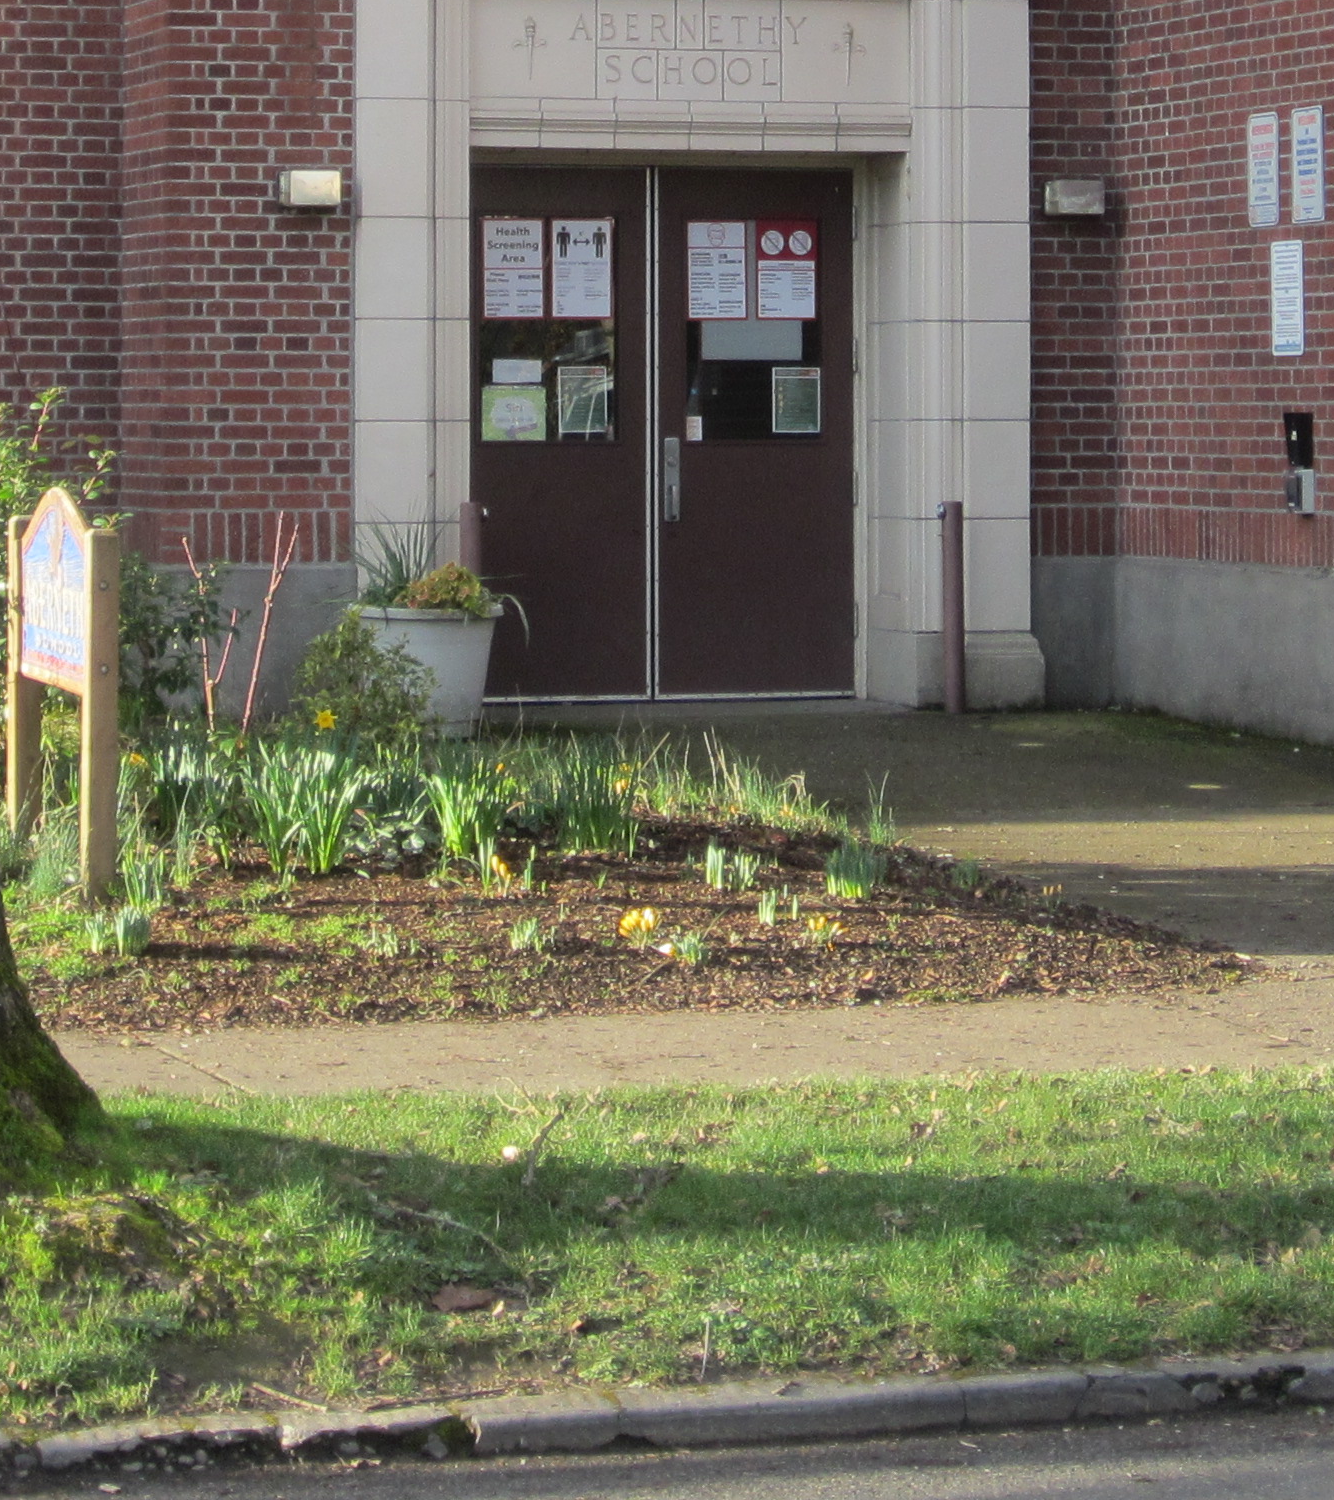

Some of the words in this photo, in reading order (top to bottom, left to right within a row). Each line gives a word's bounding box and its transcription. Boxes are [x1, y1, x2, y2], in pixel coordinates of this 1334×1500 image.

[568, 12, 807, 46] ABERNETHY
[604, 54, 778, 87] SCHOOL
[495, 226, 530, 237] Health
[486, 240, 540, 252] Screening
[500, 254, 526, 263] Area
